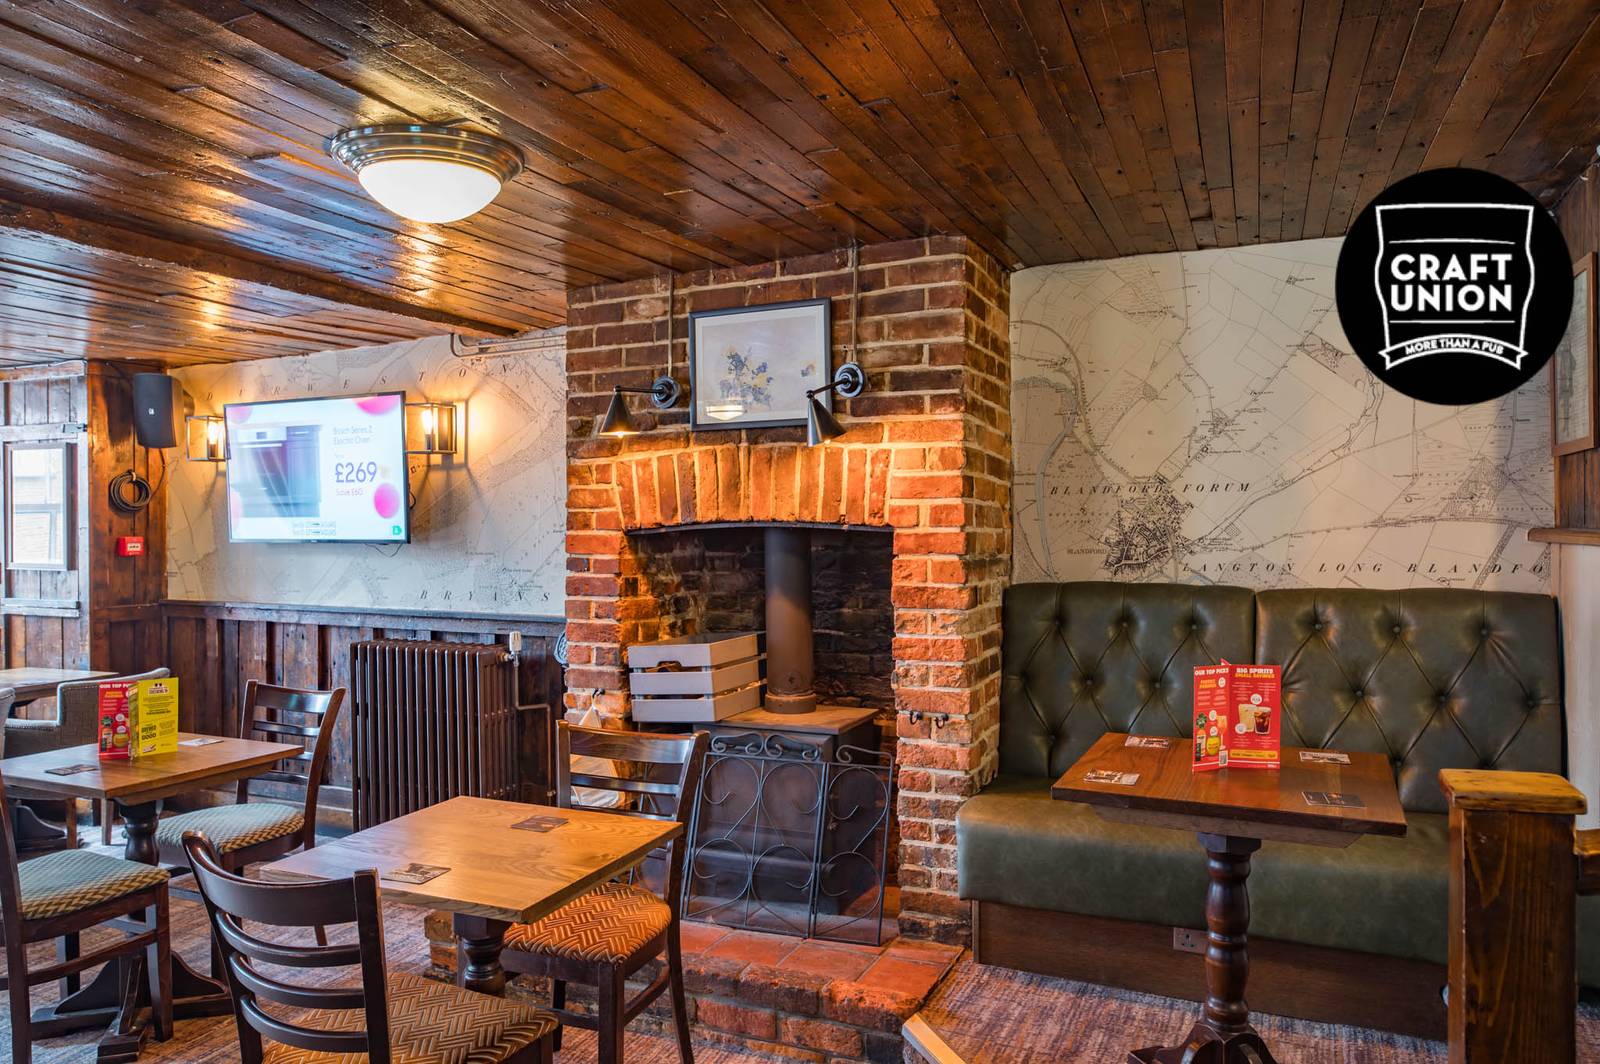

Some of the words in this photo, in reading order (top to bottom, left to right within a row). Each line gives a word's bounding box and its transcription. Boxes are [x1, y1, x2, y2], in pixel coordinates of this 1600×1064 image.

[335, 461, 377, 483] £269
[1050, 485, 1164, 496] BLANDFORD
[1182, 482, 1251, 493] FORUM
[1182, 562, 1296, 573] LANGTON
[1319, 562, 1383, 573] LONG
